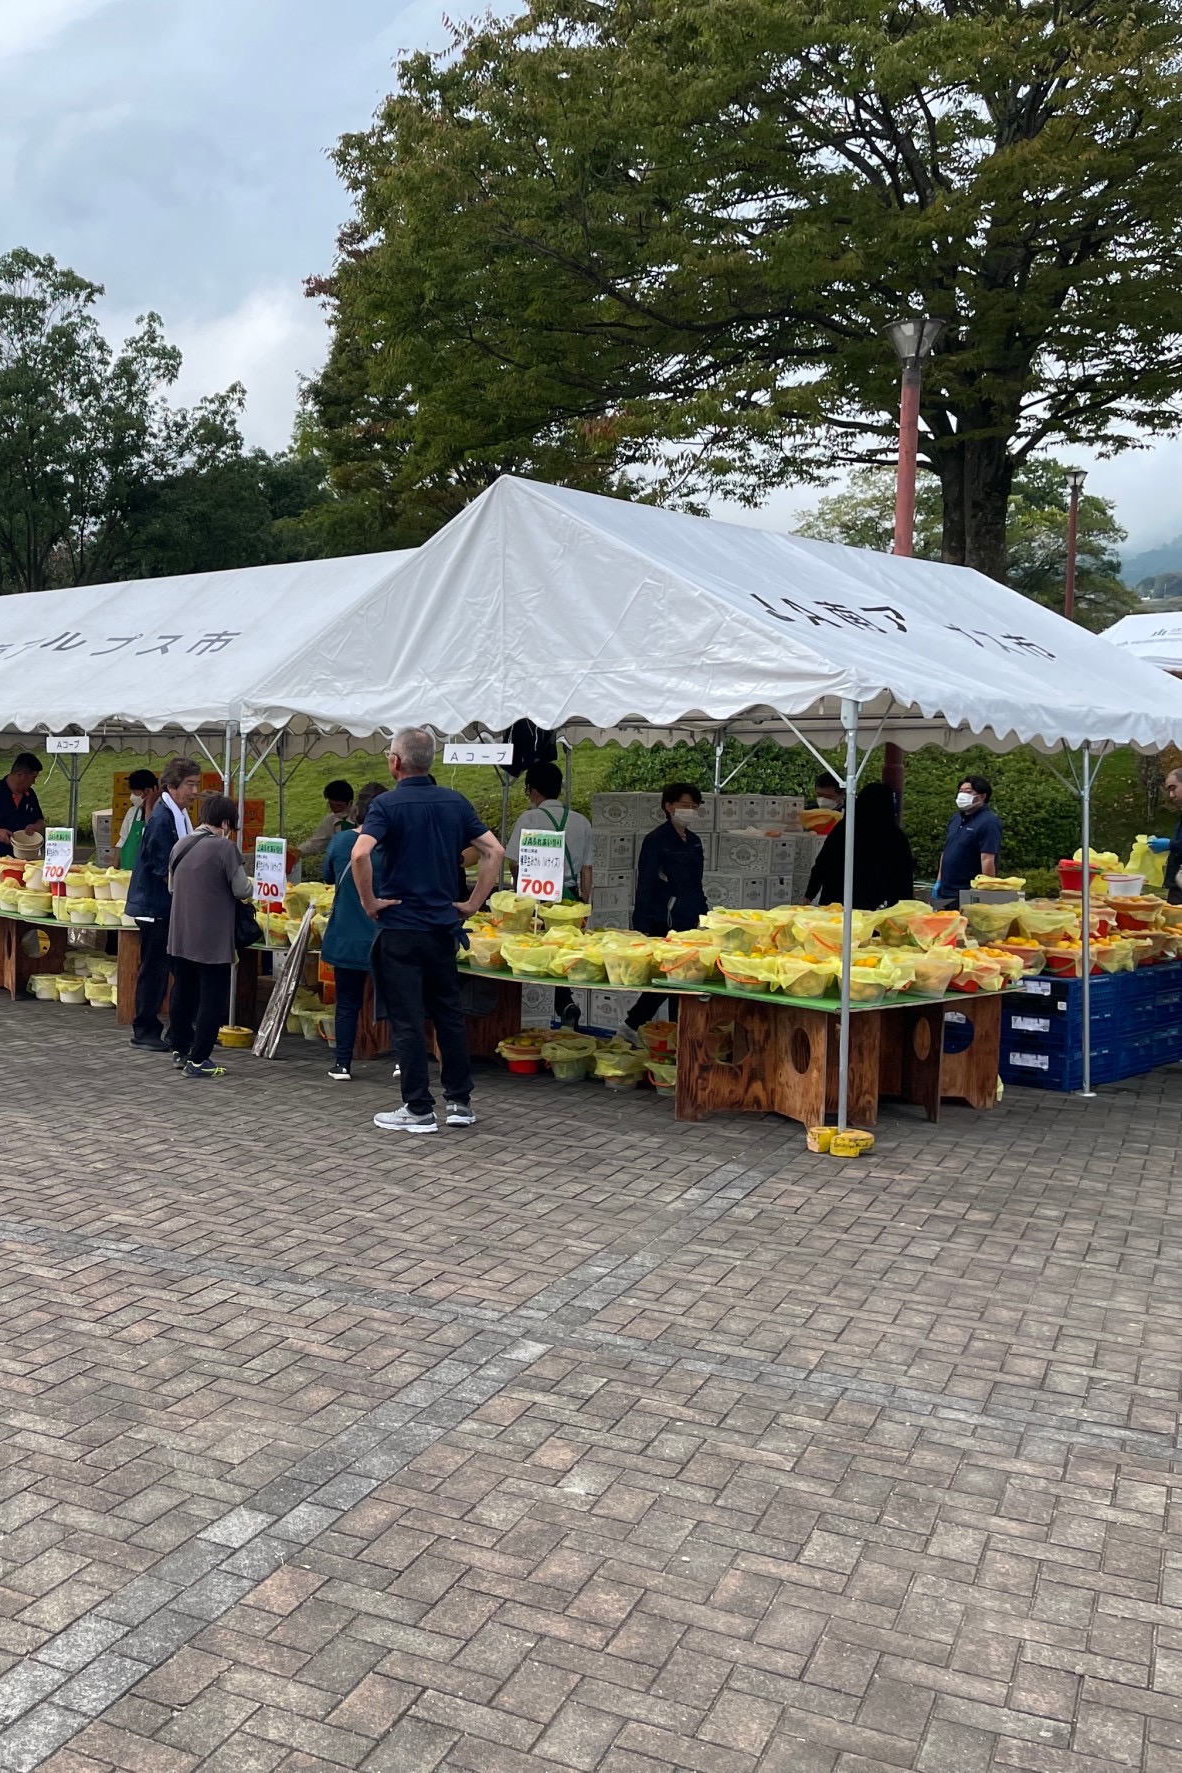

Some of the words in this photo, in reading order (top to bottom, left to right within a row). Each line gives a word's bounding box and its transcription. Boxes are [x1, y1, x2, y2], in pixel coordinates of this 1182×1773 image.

[56, 739, 81, 750] Aコープ
[45, 865, 64, 878] 700
[257, 881, 279, 897] 700
[521, 878, 555, 896] 700
